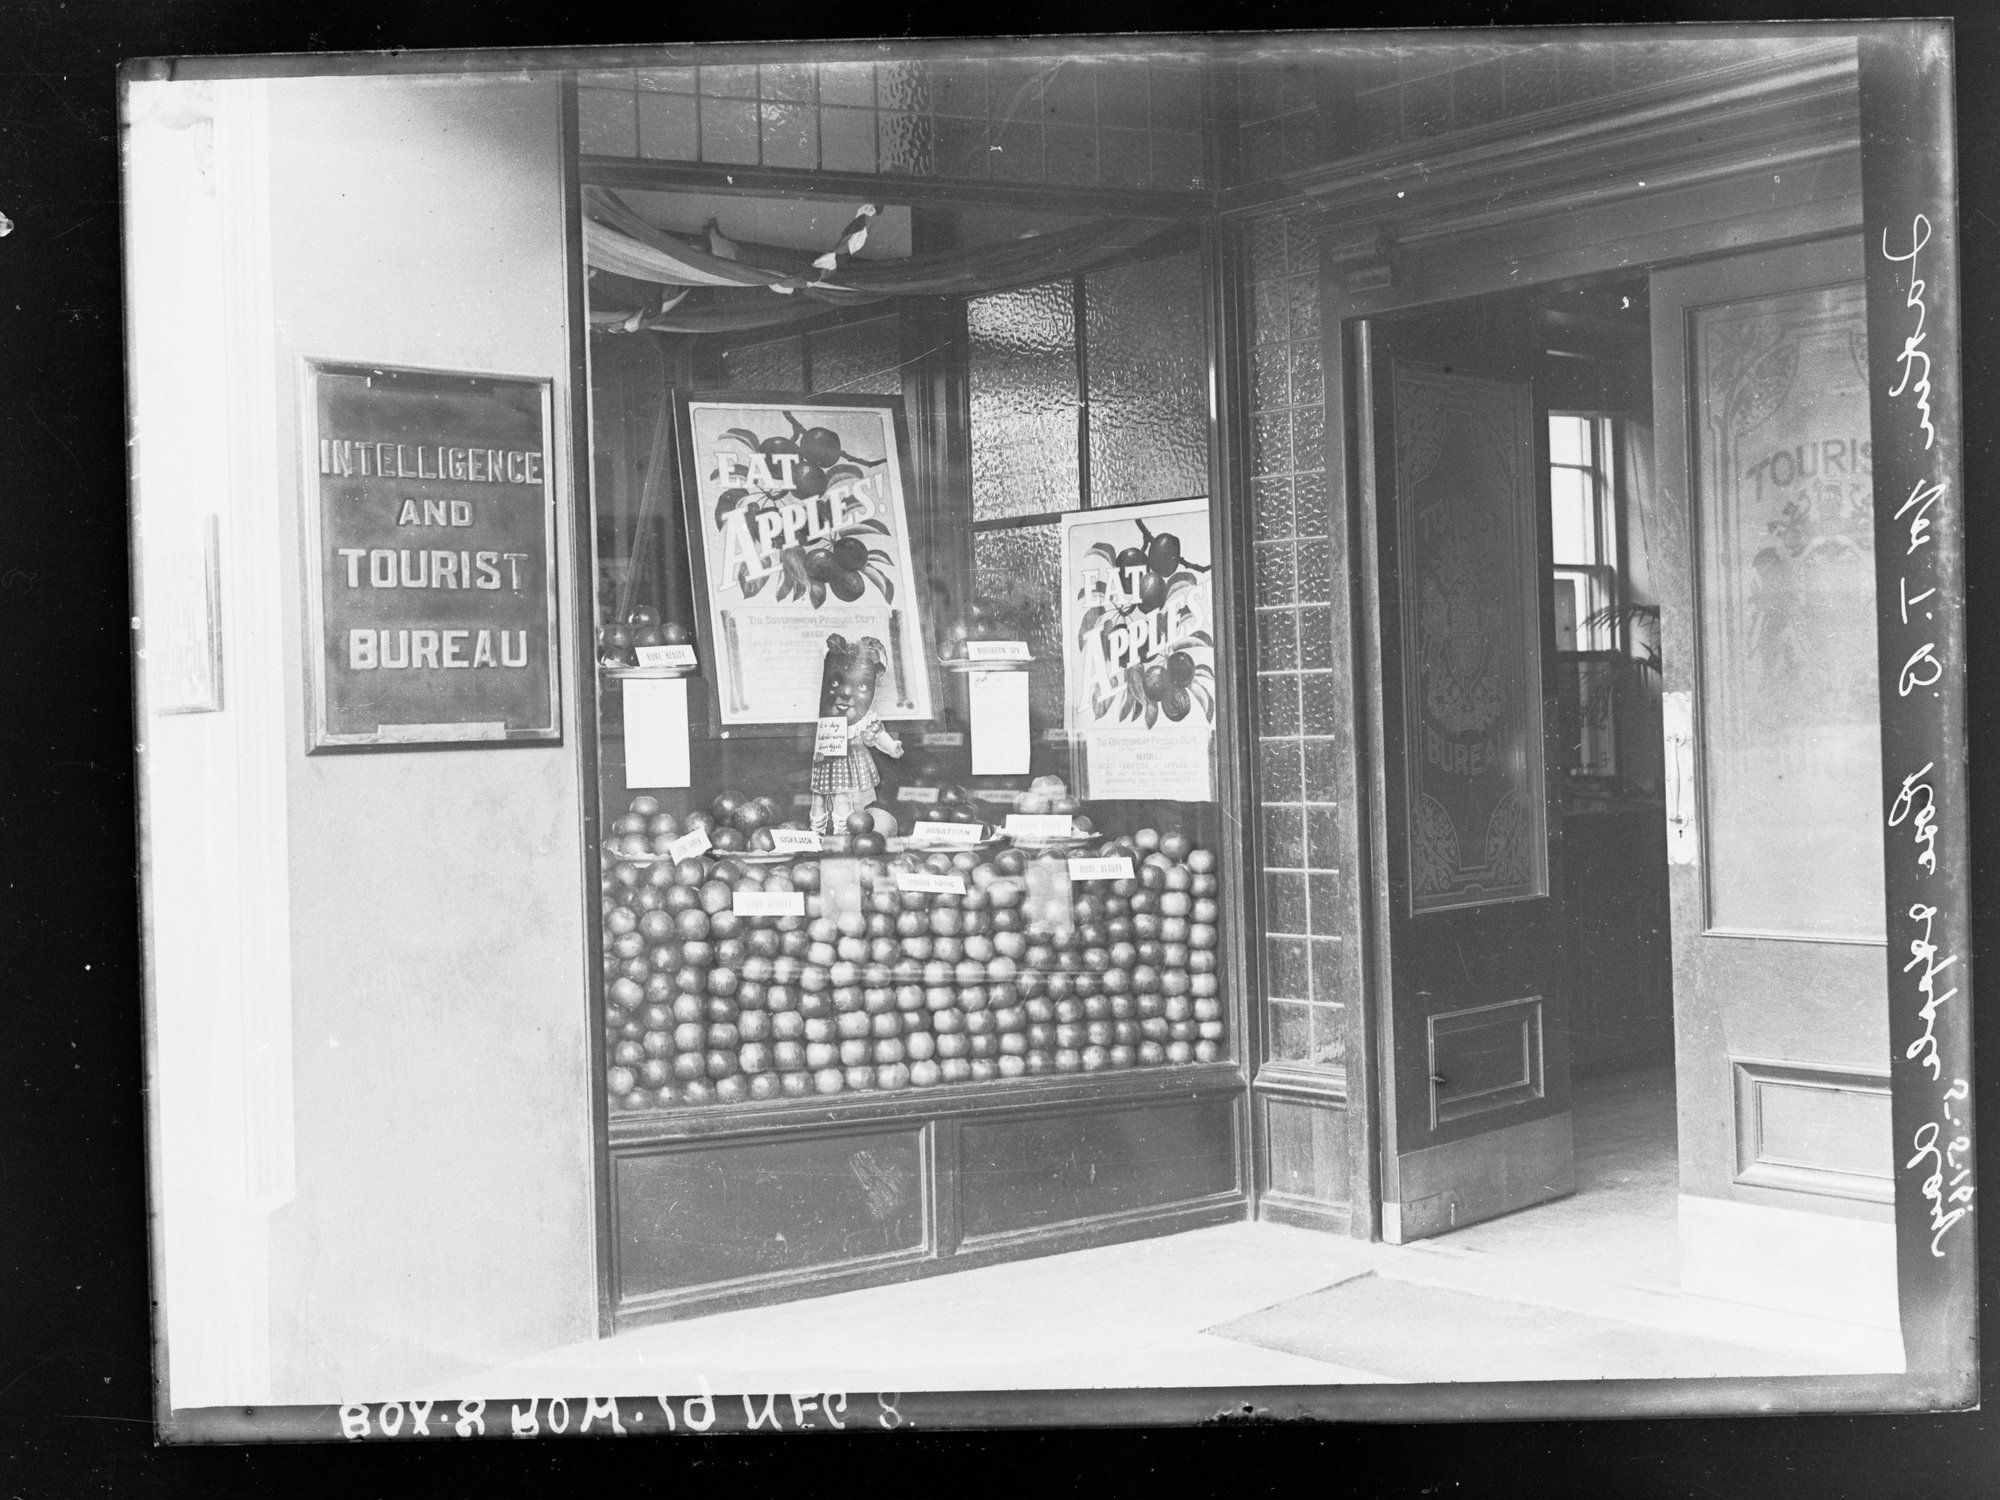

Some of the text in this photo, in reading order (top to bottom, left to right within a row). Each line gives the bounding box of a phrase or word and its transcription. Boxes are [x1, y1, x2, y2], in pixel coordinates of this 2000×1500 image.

[320, 439, 543, 485] INTELLIGENCE
[713, 451, 800, 490] EAT
[397, 498, 474, 528] AND
[717, 473, 887, 592] APPLES!
[338, 548, 529, 591] TOURIST
[1081, 565, 1147, 608] EAT
[349, 629, 528, 670] BUREAU
[665, 650, 686, 660] BEAUTY
[925, 827, 971, 837] JONATHAN
